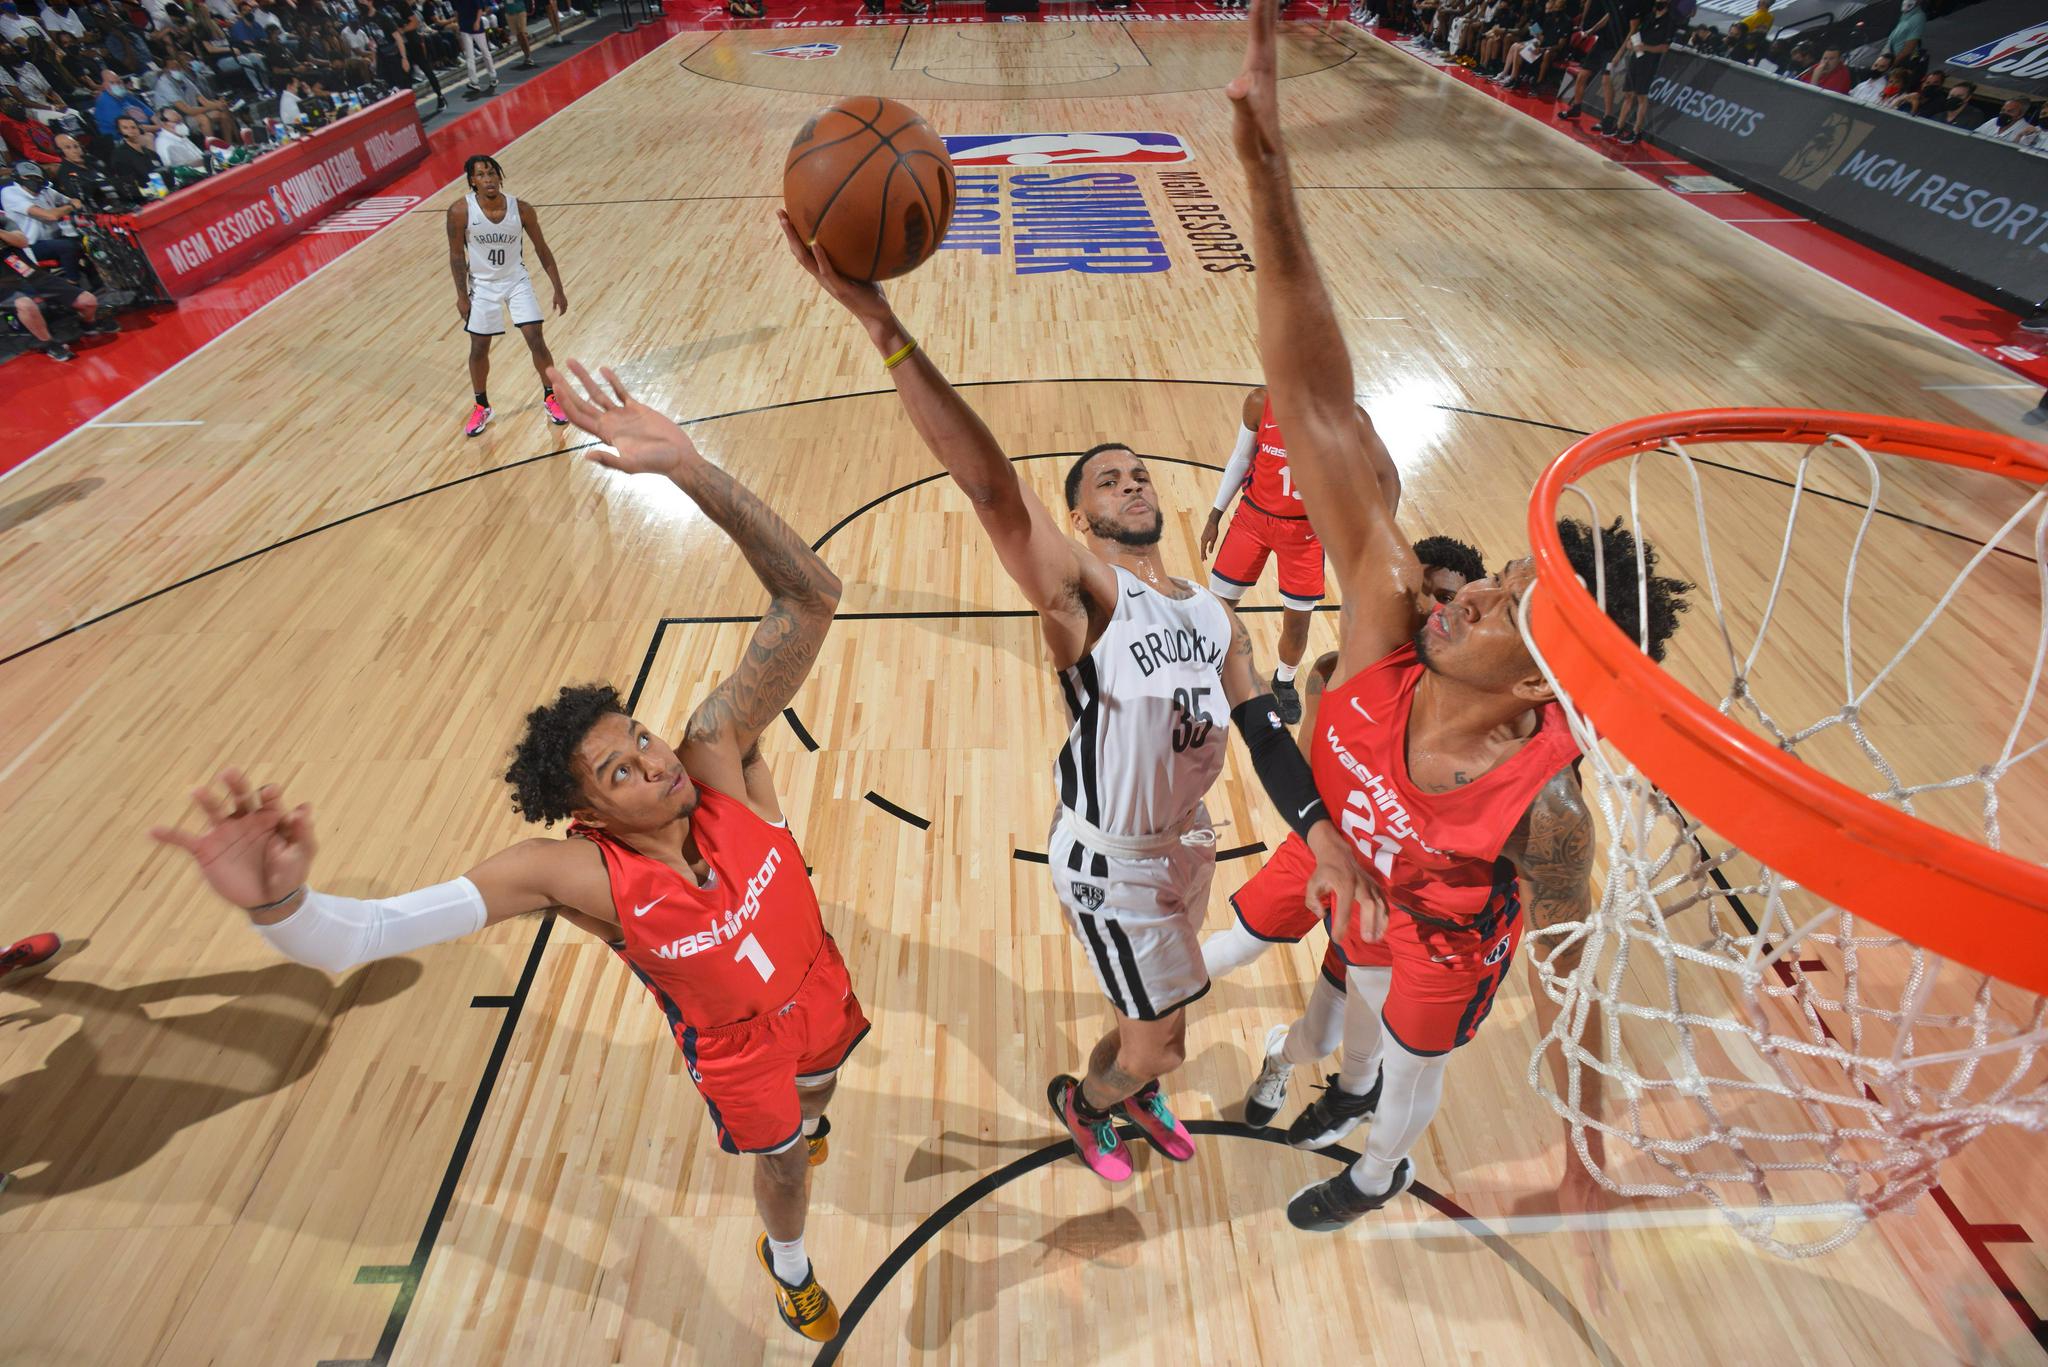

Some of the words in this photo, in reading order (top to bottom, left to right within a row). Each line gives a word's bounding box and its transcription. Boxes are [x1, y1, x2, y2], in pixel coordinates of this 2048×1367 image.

[775, 19, 844, 28] MGM
[855, 16, 985, 25] RESORTS
[1043, 13, 1154, 22] SUMMER
[1157, 13, 1248, 22] LEAGUE
[1670, 86, 1765, 137] RESORTS
[165, 232, 212, 275] MGM
[207, 200, 276, 253] RESORTS
[282, 164, 336, 218] SUMMER
[324, 146, 367, 195] LEAGUE
[1157, 171, 1213, 199] MGM
[1839, 150, 1922, 197] MGM
[1908, 174, 2048, 254] RESORT
[1009, 172, 1172, 275] SUMMER
[1173, 204, 1256, 273] RESORTS
[488, 249, 505, 265] 40
[1262, 443, 1287, 458] was
[1172, 687, 1213, 753] 35
[1341, 790, 1403, 880] 21
[650, 847, 782, 959] washington
[1073, 883, 1102, 901] NETS
[734, 932, 776, 983] 1
